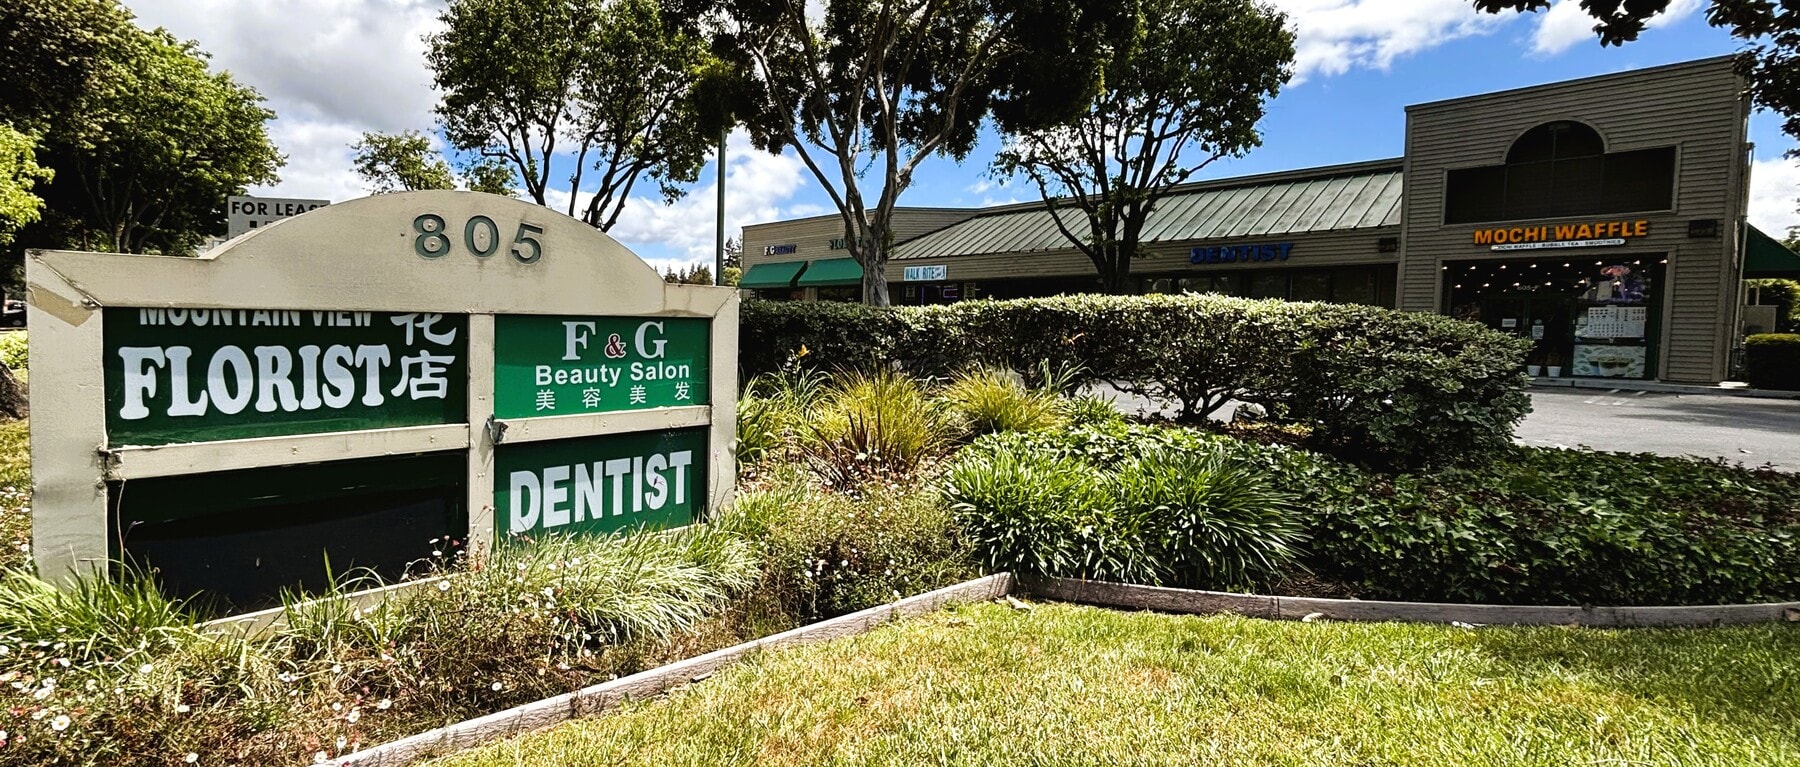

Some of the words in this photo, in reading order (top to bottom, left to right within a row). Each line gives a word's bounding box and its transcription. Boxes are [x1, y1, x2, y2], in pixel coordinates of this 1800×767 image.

[232, 201, 268, 215] FOR
[276, 203, 328, 216] LEAS
[413, 212, 545, 264] 805
[1474, 226, 1547, 244] MOCHI
[1554, 219, 1648, 241] WAFFLE
[1189, 242, 1293, 264] DENTIST
[906, 267, 920, 280] WALK
[561, 321, 596, 361] F
[604, 333, 627, 358] &
[634, 321, 668, 359] G
[118, 344, 391, 420] FLORIST
[535, 364, 622, 387] Beauty
[630, 361, 690, 381] Salon
[510, 450, 692, 533] DENTIST
